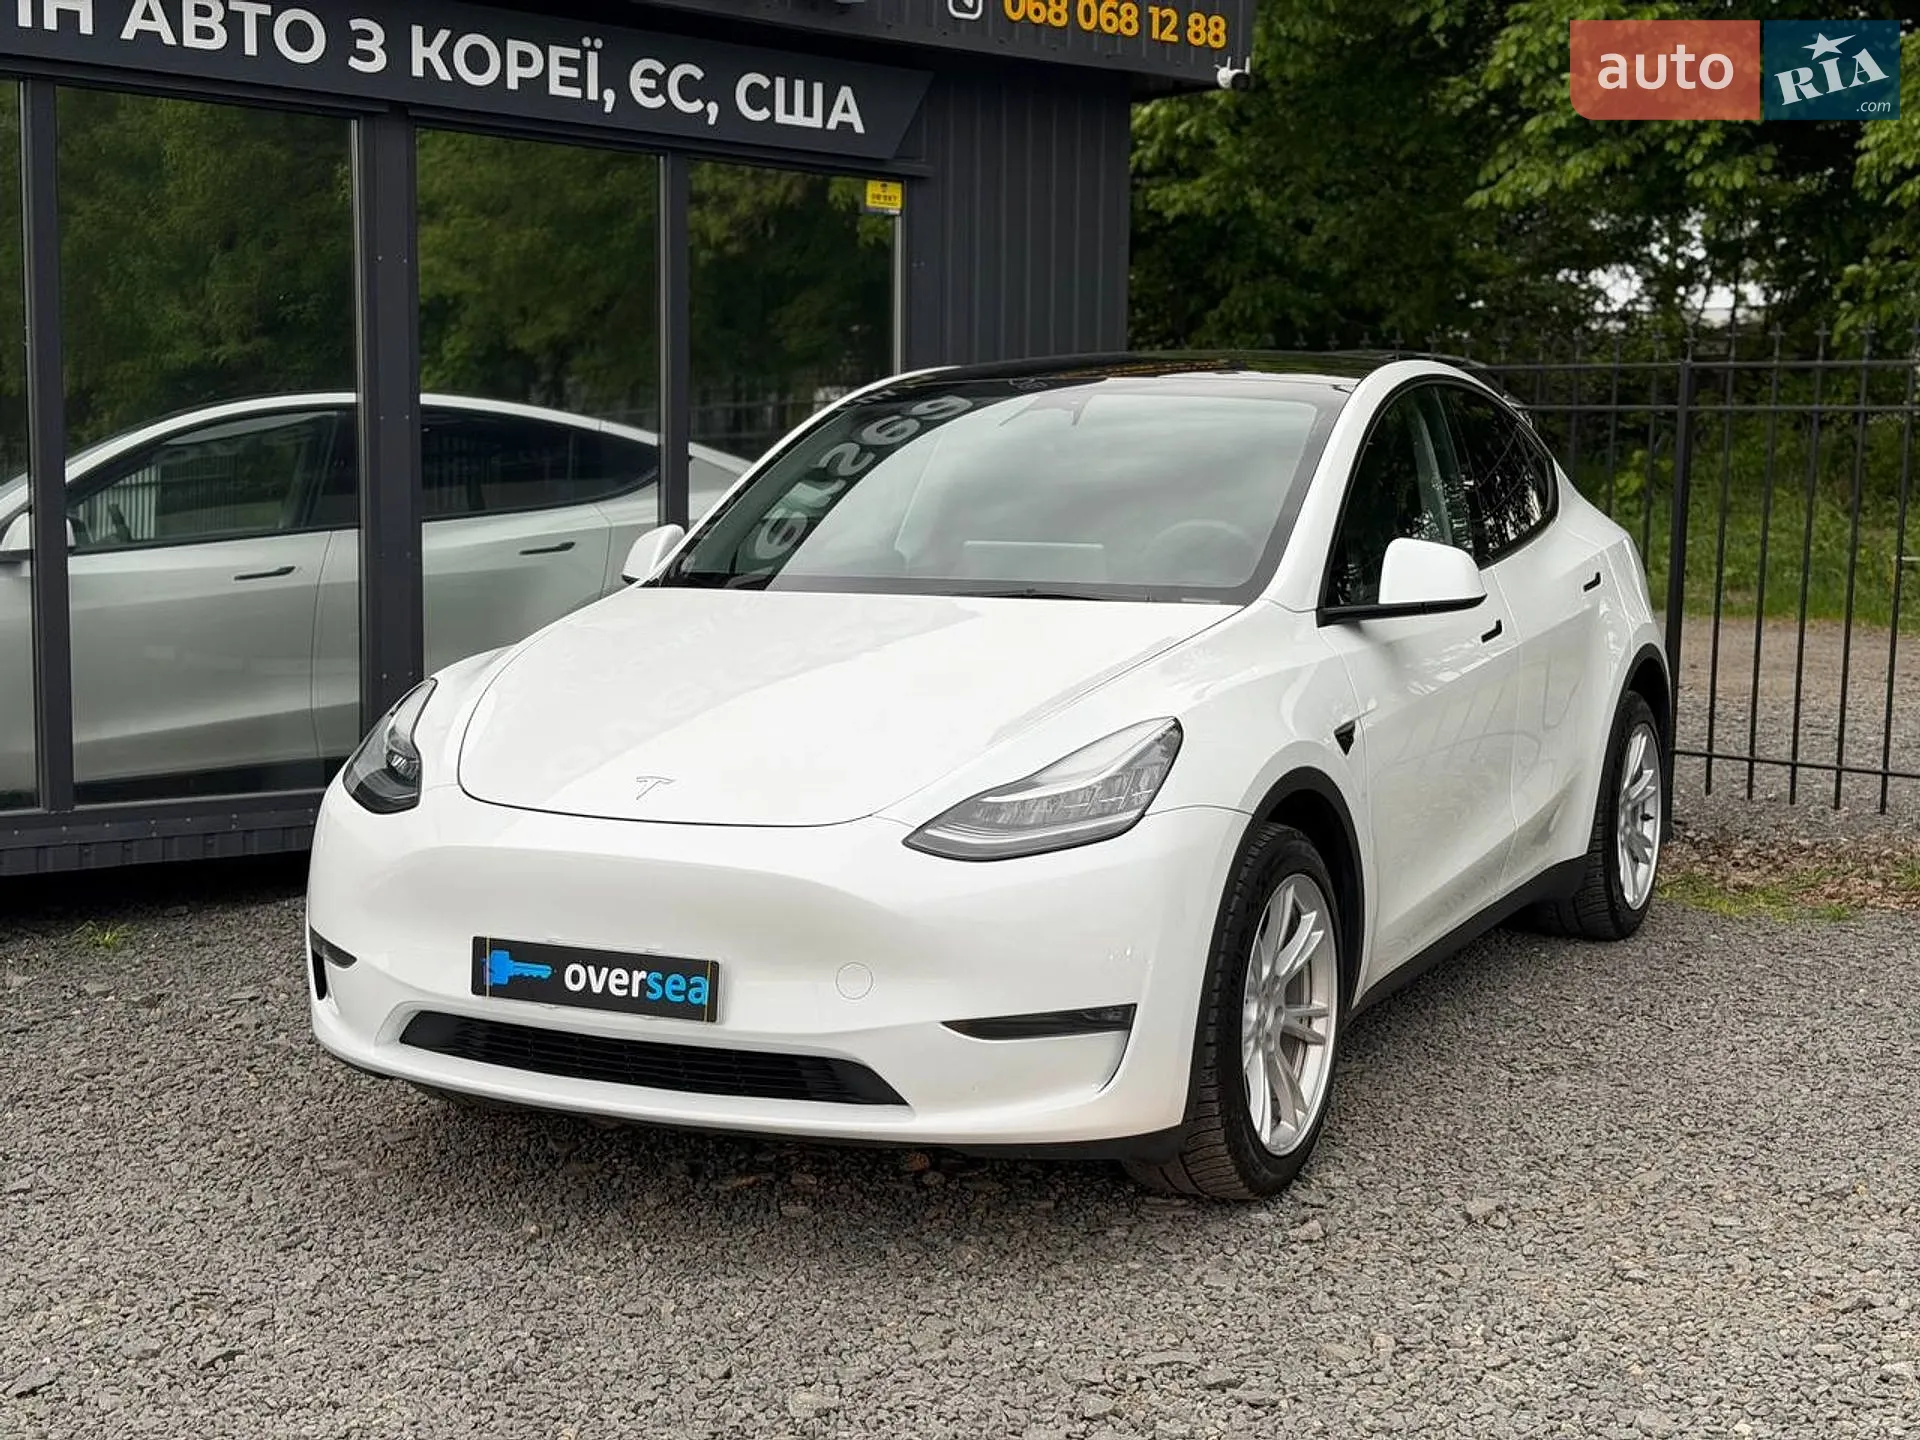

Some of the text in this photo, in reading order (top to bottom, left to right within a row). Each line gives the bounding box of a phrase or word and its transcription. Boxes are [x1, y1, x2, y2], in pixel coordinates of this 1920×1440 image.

[1004, 0, 1226, 48] 068 068 12 88
[119, 0, 327, 64] АВТО
[411, 24, 616, 113] КОРЕЇ,
[628, 58, 719, 126] ЄС,
[735, 72, 865, 134] США
[563, 962, 710, 1006] oversea
